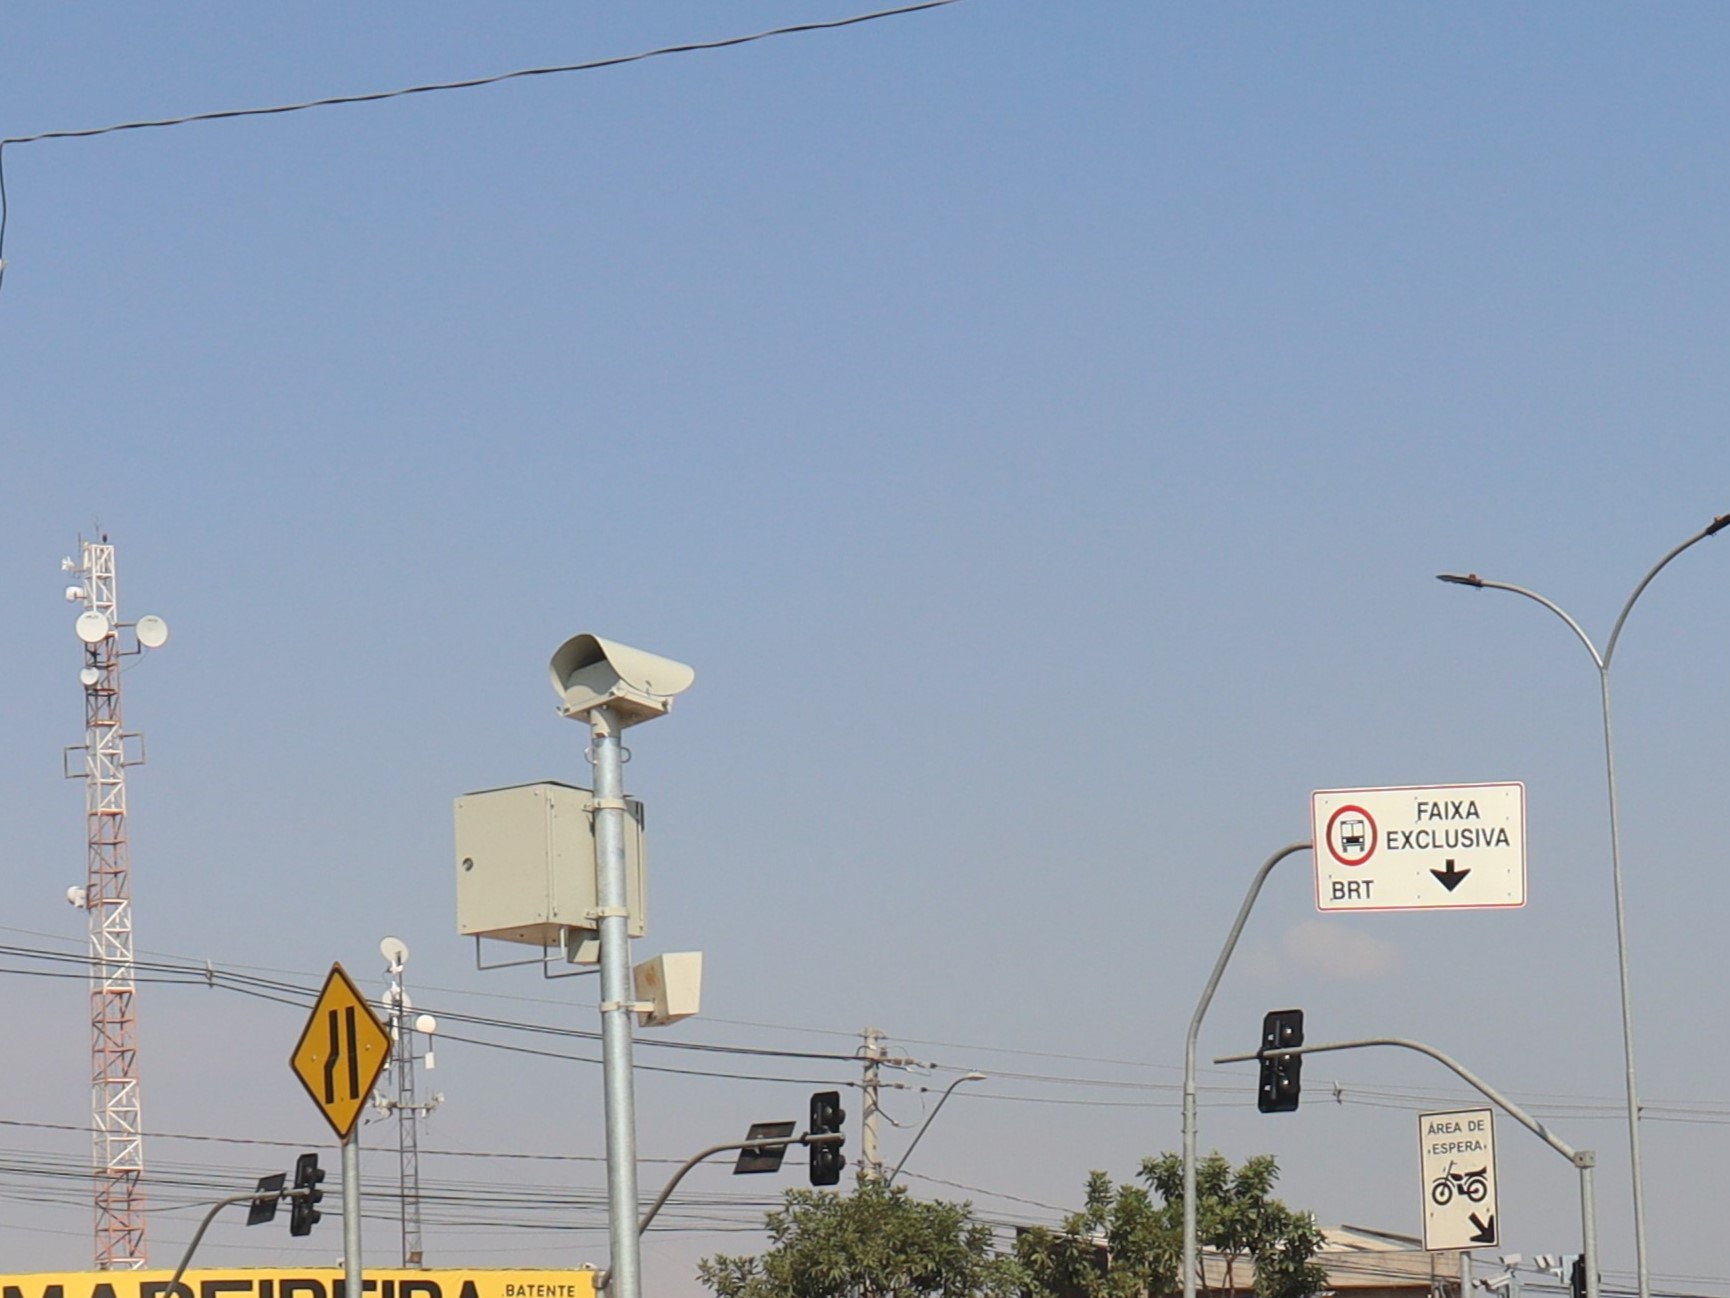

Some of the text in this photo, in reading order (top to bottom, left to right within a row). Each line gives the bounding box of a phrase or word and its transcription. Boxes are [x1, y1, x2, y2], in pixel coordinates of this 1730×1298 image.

[1416, 800, 1480, 821] FAIXA
[1386, 827, 1510, 850] EXCLUSIVA
[1332, 879, 1374, 900] BRT
[1468, 1120, 1485, 1132] DE
[1432, 1140, 1483, 1155] ESPERA
